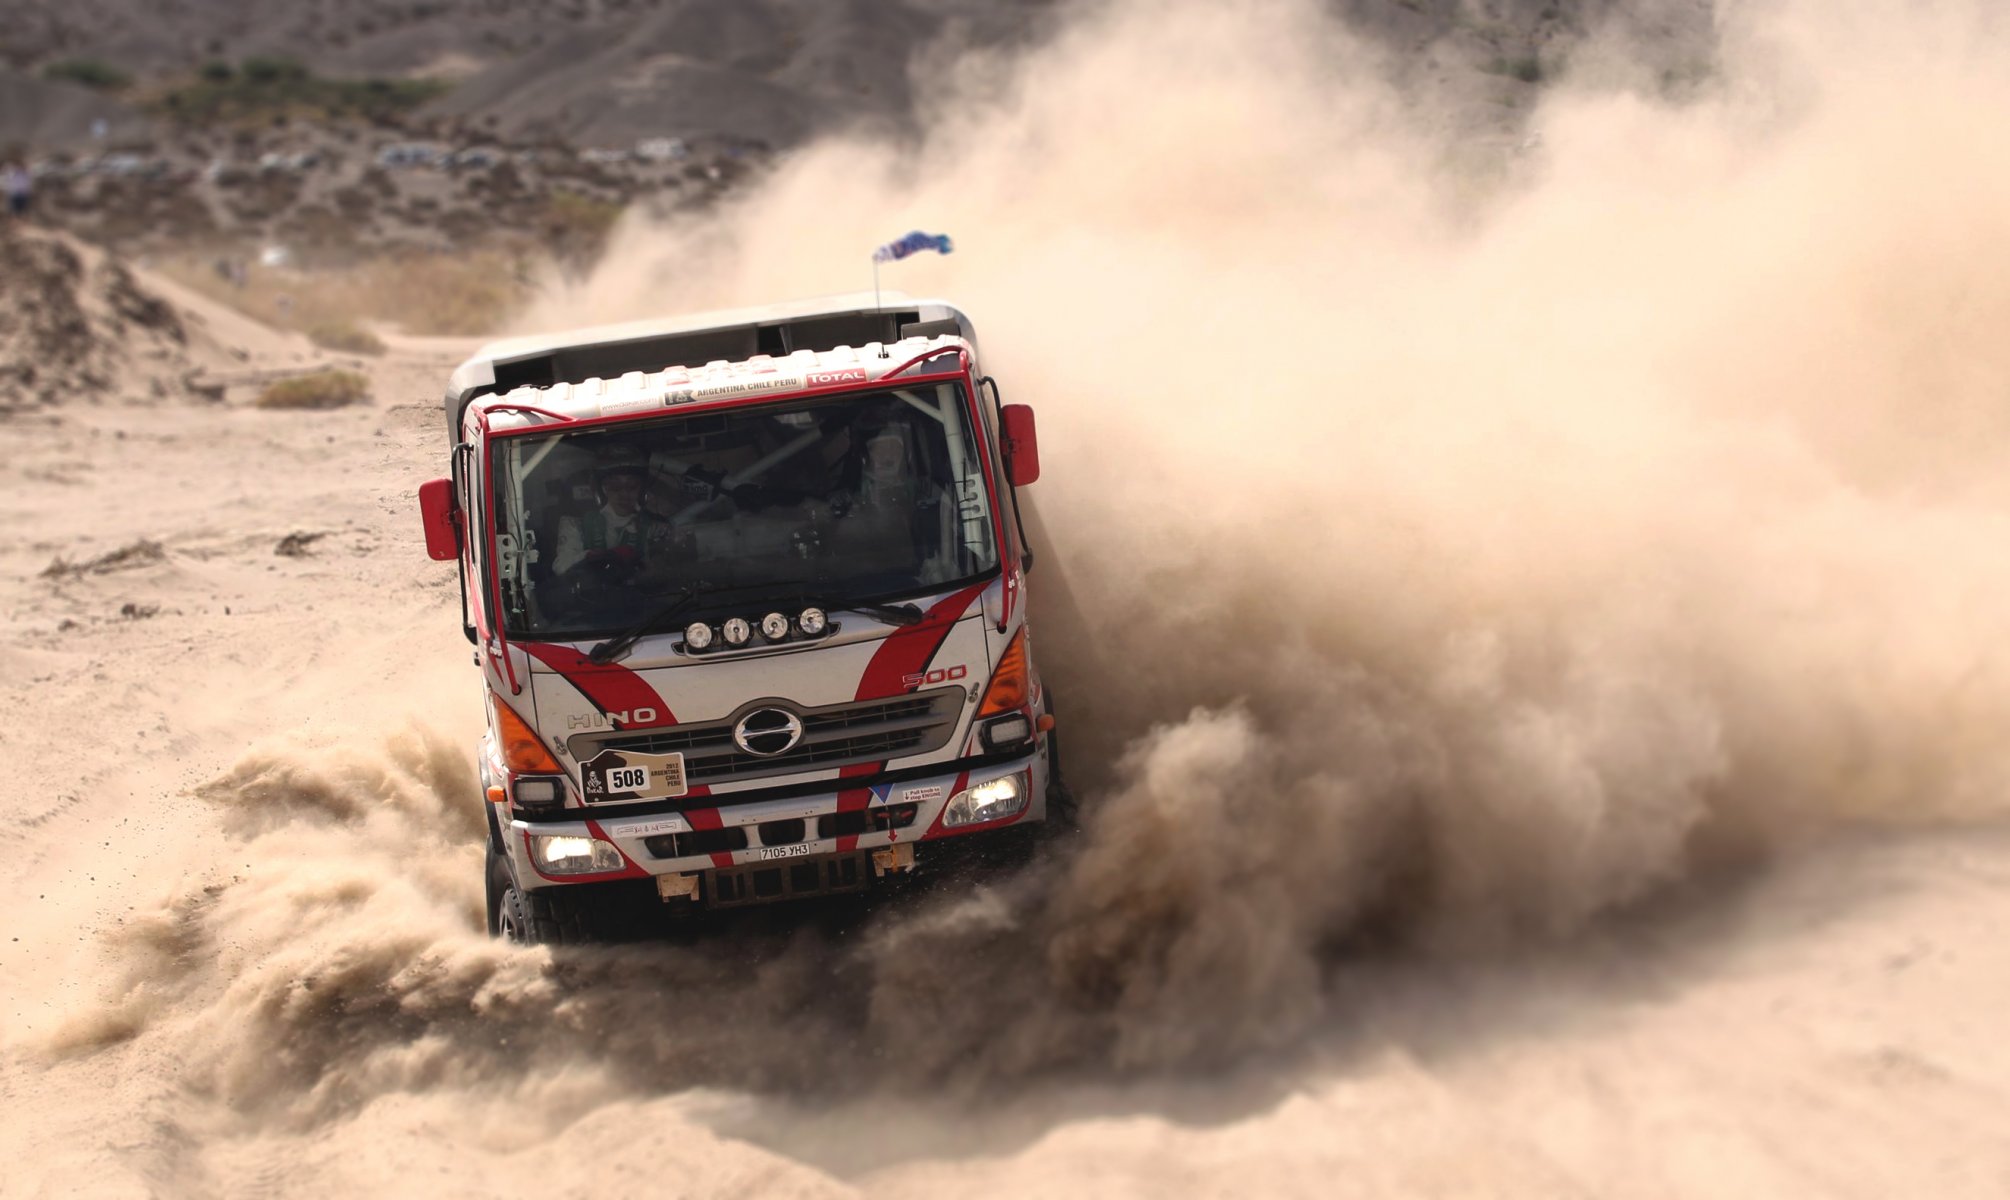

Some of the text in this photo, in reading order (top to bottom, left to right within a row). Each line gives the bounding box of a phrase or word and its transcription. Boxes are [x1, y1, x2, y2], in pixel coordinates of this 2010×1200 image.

[808, 371, 864, 383] TOTAL
[697, 378, 797, 397] ARGENTINA CHILE PERU
[903, 665, 967, 688] 500
[567, 707, 657, 729] HINO
[612, 769, 645, 789] 508
[650, 769, 680, 777] ARGENTINA
[762, 847, 786, 859] 7105
